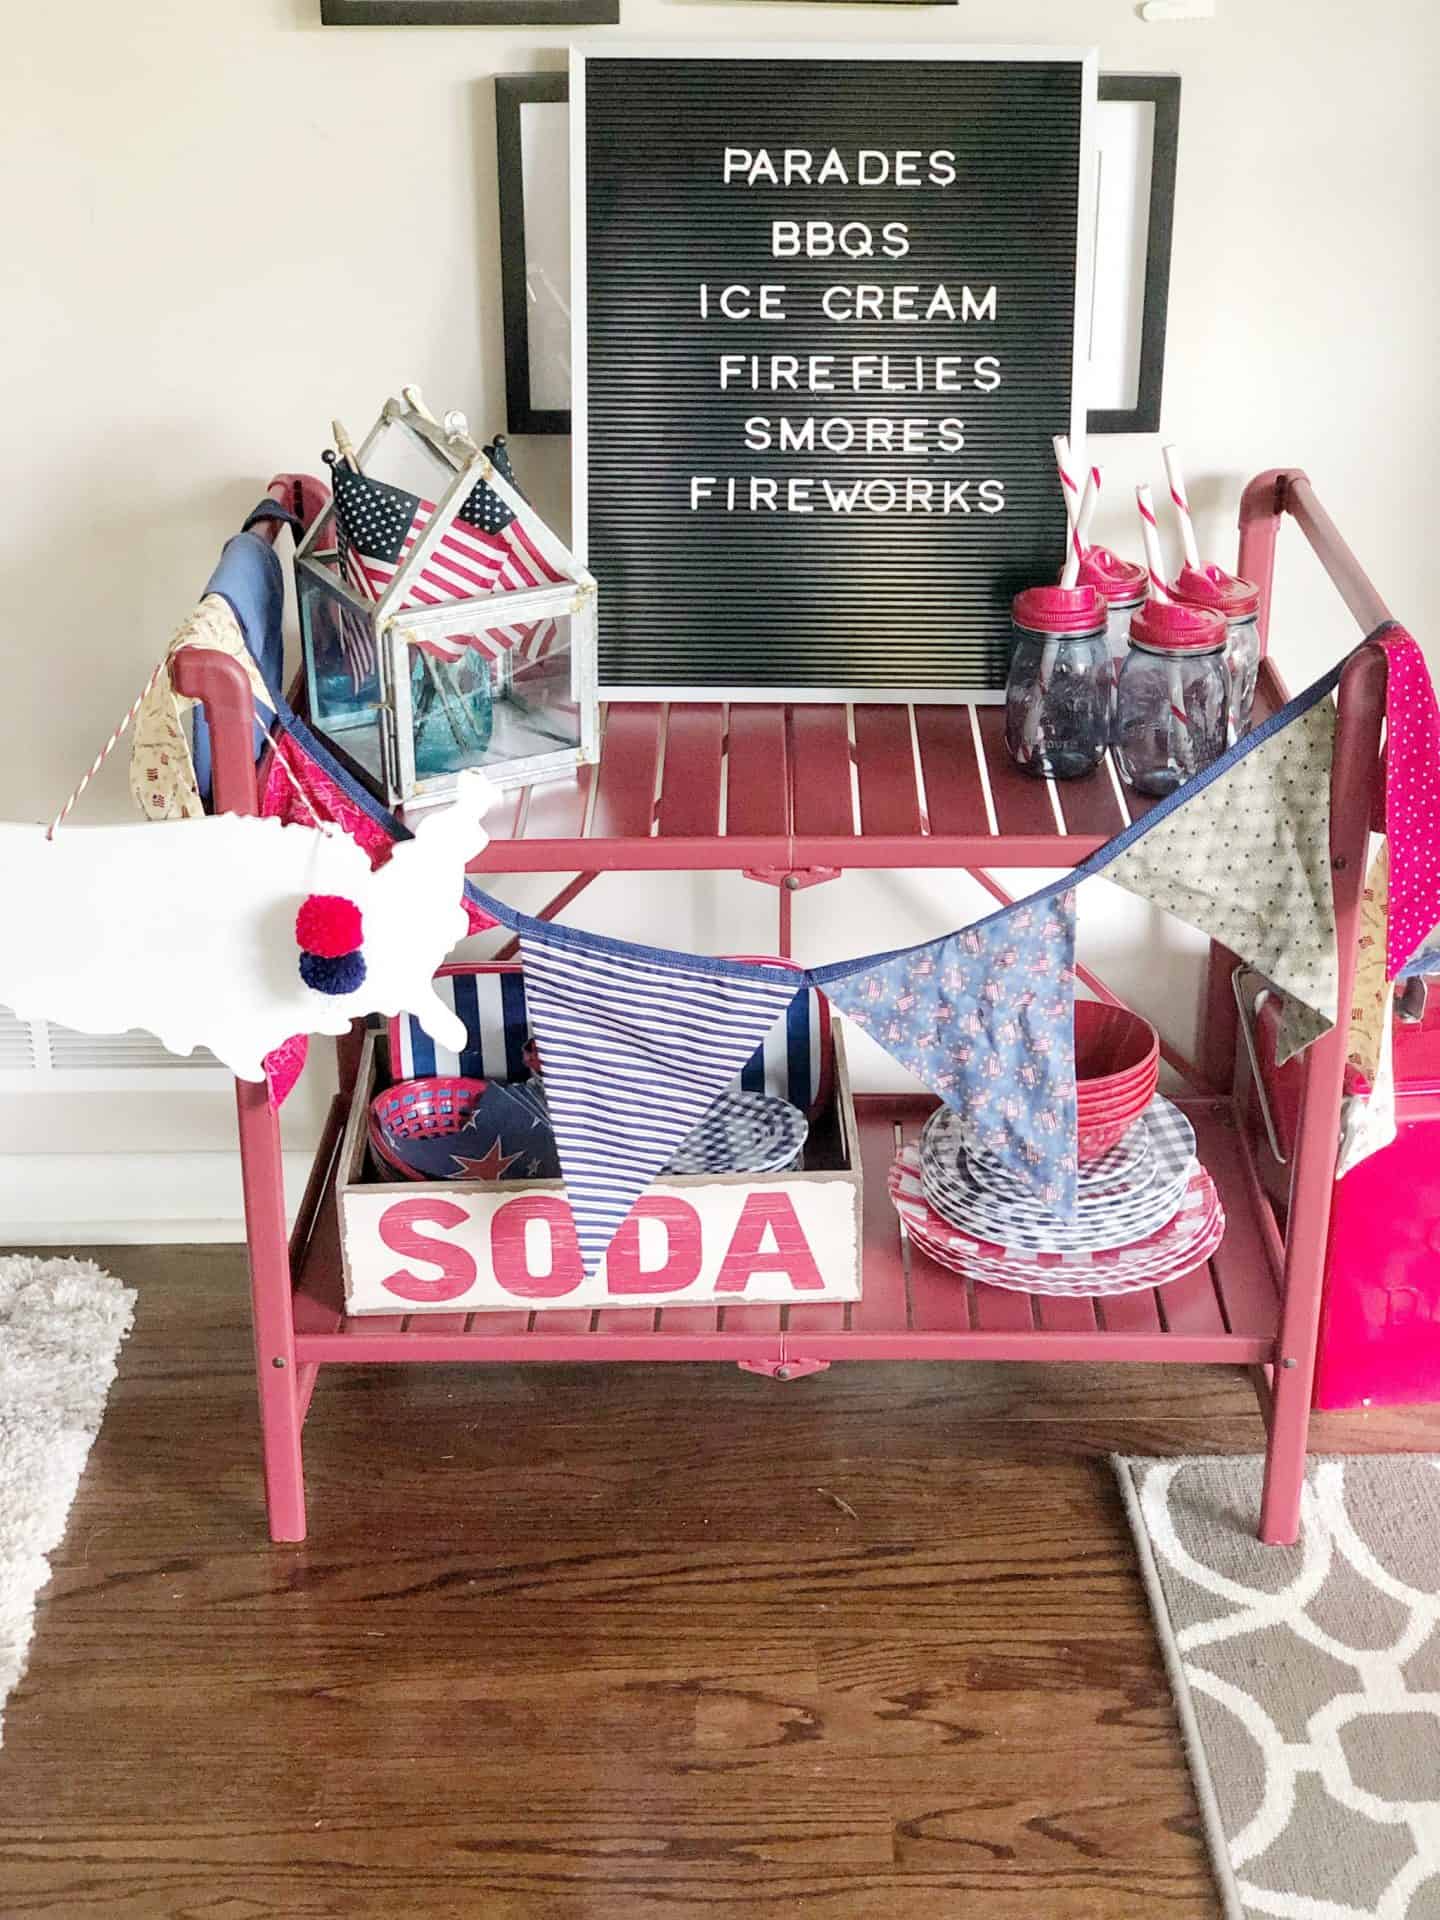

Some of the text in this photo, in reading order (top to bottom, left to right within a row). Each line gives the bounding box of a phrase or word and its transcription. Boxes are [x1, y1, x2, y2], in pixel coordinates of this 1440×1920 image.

[722, 147, 957, 187] PARADES
[771, 221, 911, 261] BBQS
[699, 284, 998, 323] ICE CREAM
[719, 354, 1002, 393] FIREFLIES
[743, 416, 966, 454] SMORES
[689, 476, 1006, 515] FIREWORKS
[378, 1191, 826, 1302] SODA
